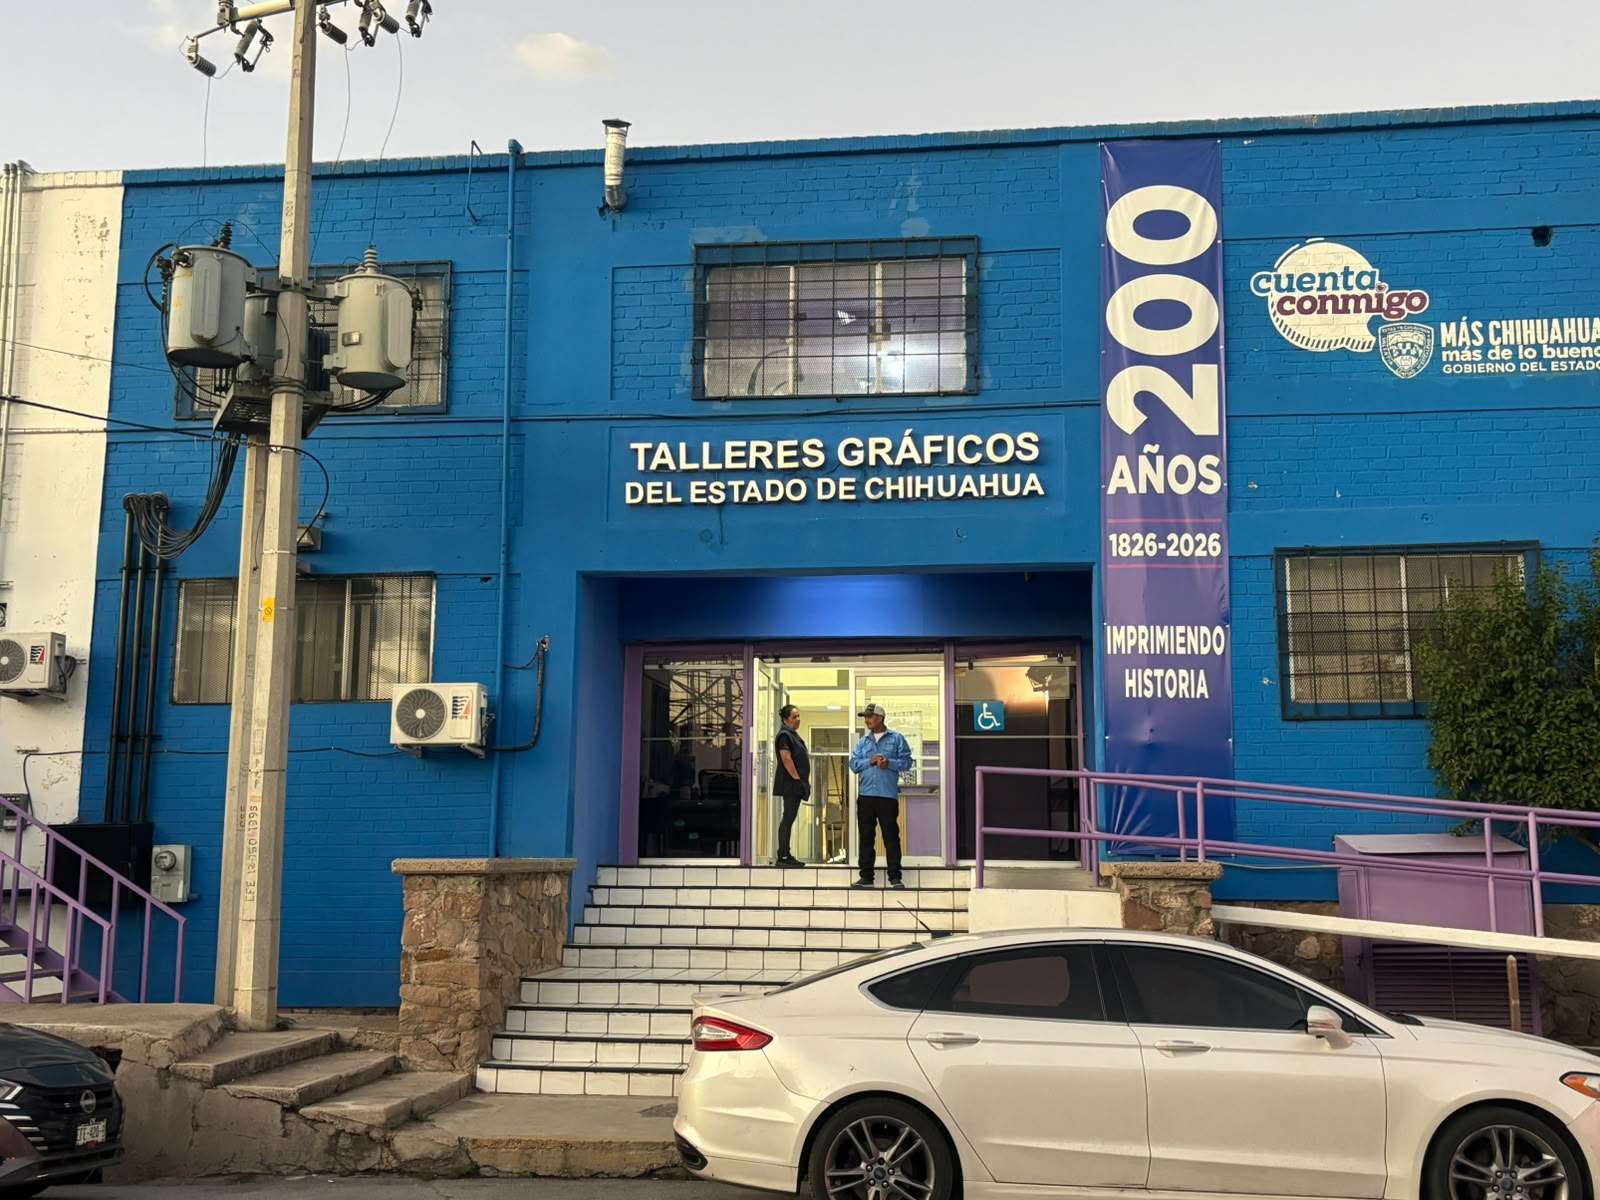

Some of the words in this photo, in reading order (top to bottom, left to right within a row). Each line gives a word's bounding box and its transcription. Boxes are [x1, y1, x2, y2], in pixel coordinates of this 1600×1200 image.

[1252, 265, 1378, 293] cuenta
[1105, 184, 1219, 437] 200
[1276, 284, 1428, 319] conmigo
[1440, 316, 1484, 347] MÁS
[1488, 317, 1600, 346] CHIHUAHUA
[1441, 346, 1483, 361] más
[1487, 345, 1513, 360] de
[1518, 345, 1537, 360] lo
[1442, 362, 1516, 374] GOBIERNO
[1520, 361, 1547, 373] DEL
[629, 438, 825, 471] TALLERES
[837, 428, 1040, 467] GRÁFICOS
[1107, 444, 1222, 495] AÑOS
[625, 480, 682, 504] DEL
[689, 478, 807, 504] ESTADO
[816, 477, 857, 501] DE
[864, 473, 1045, 501] CHIHUAHUA
[1108, 533, 1222, 557] 1826-2026
[1106, 625, 1225, 656] IMPRIMIENDO
[1124, 669, 1209, 699] HISTORIA
